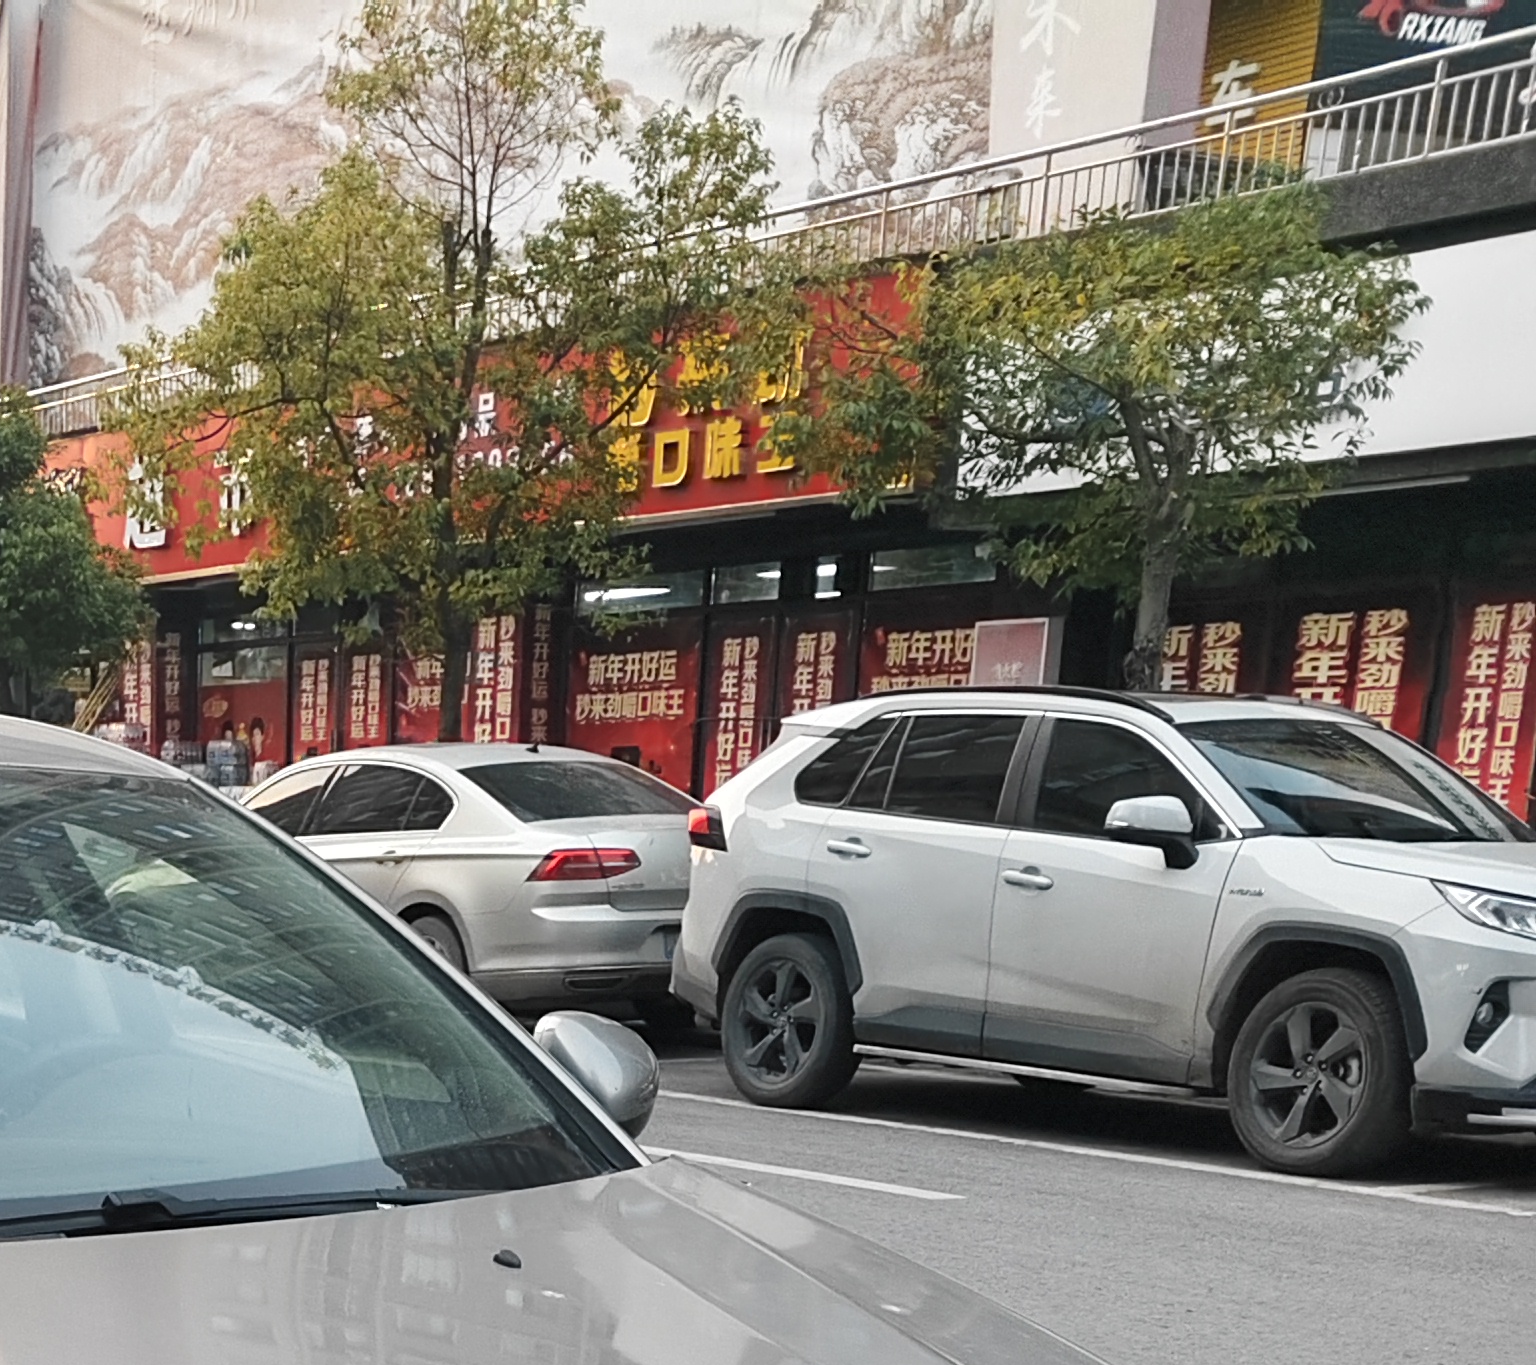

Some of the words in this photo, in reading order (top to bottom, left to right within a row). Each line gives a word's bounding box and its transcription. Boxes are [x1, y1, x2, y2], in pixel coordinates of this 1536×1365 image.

[587, 649, 678, 686] 新年开好运
